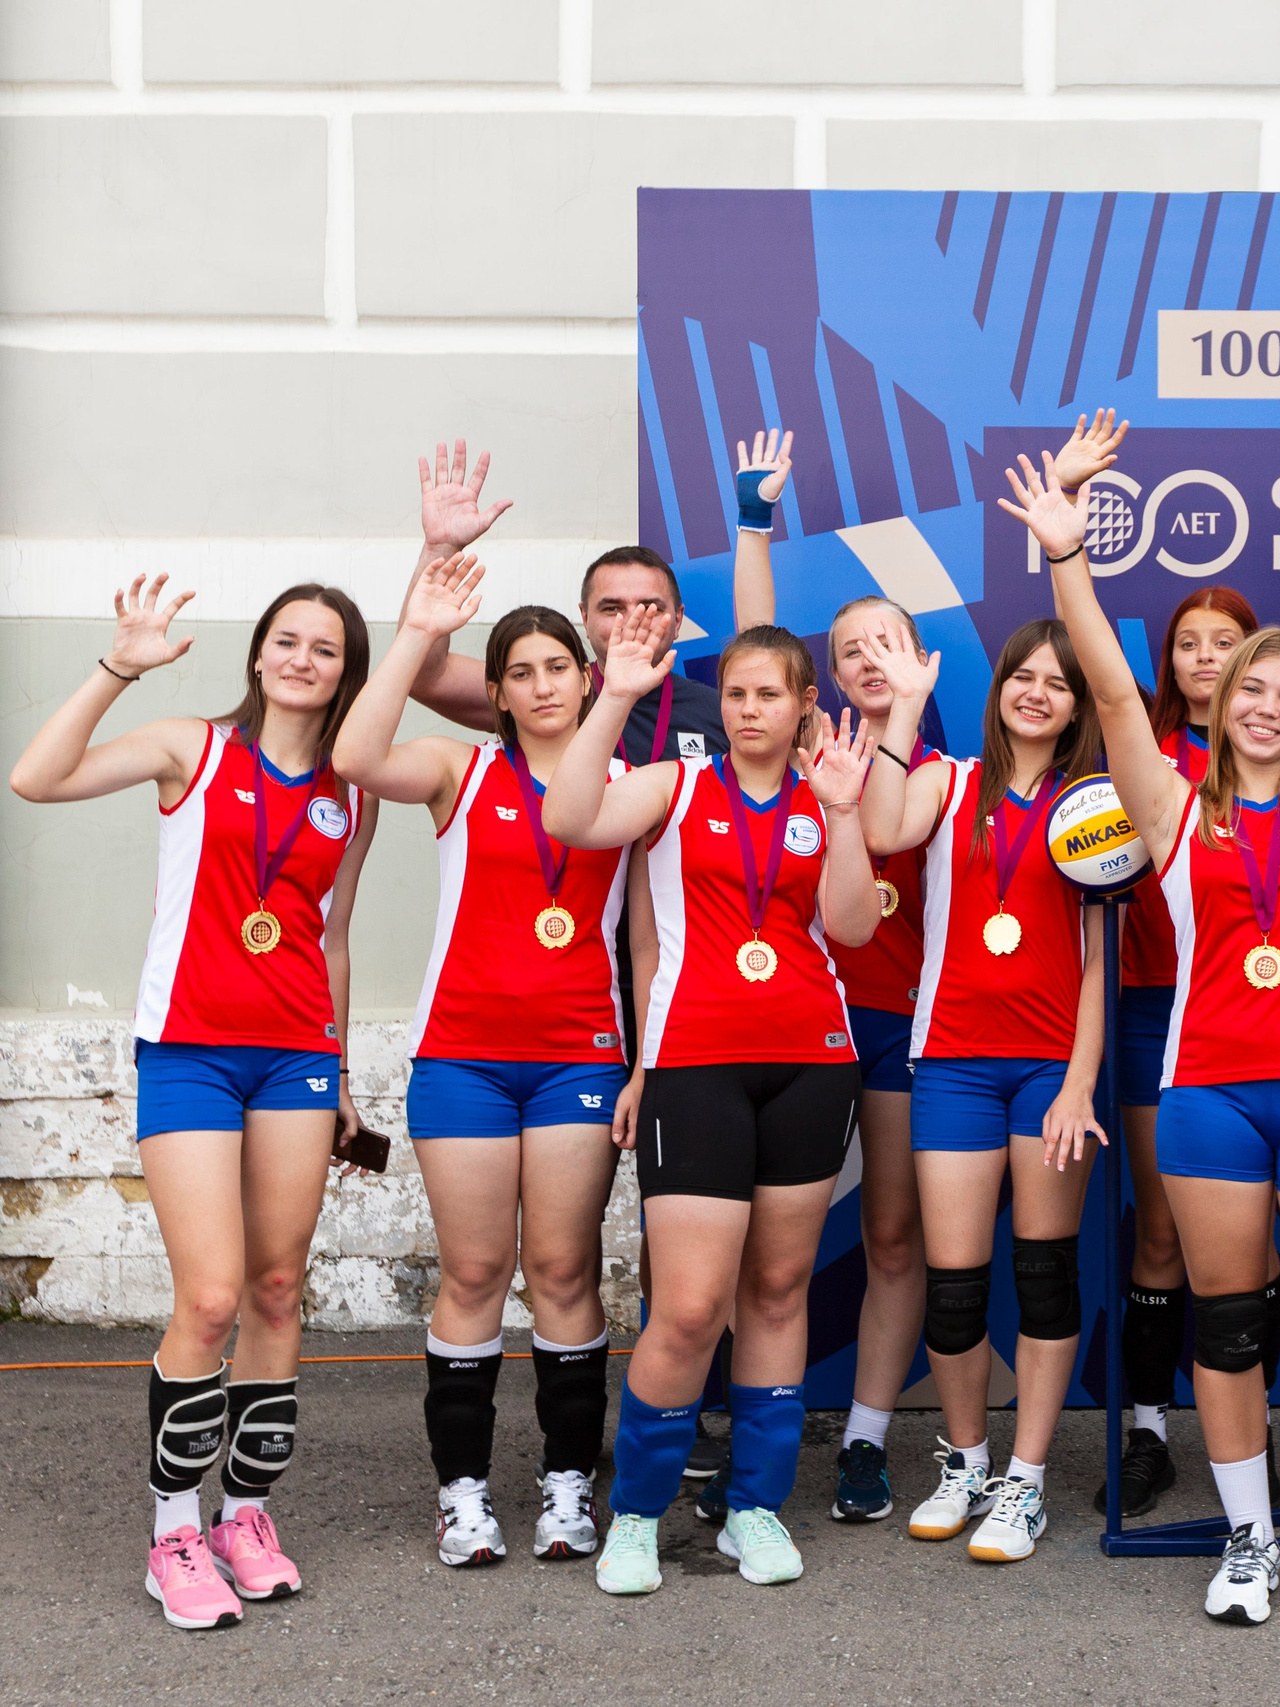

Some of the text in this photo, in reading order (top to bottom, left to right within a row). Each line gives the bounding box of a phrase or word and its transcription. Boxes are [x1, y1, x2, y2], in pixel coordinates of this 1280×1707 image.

[681, 747, 704, 755] adidas
[1059, 795, 1088, 823] Beach
[1099, 854, 1130, 872] FIVB
[1104, 865, 1133, 879] APPROVED
[1015, 1261, 1057, 1273] SELECT
[1130, 1291, 1168, 1305] ALLSIX
